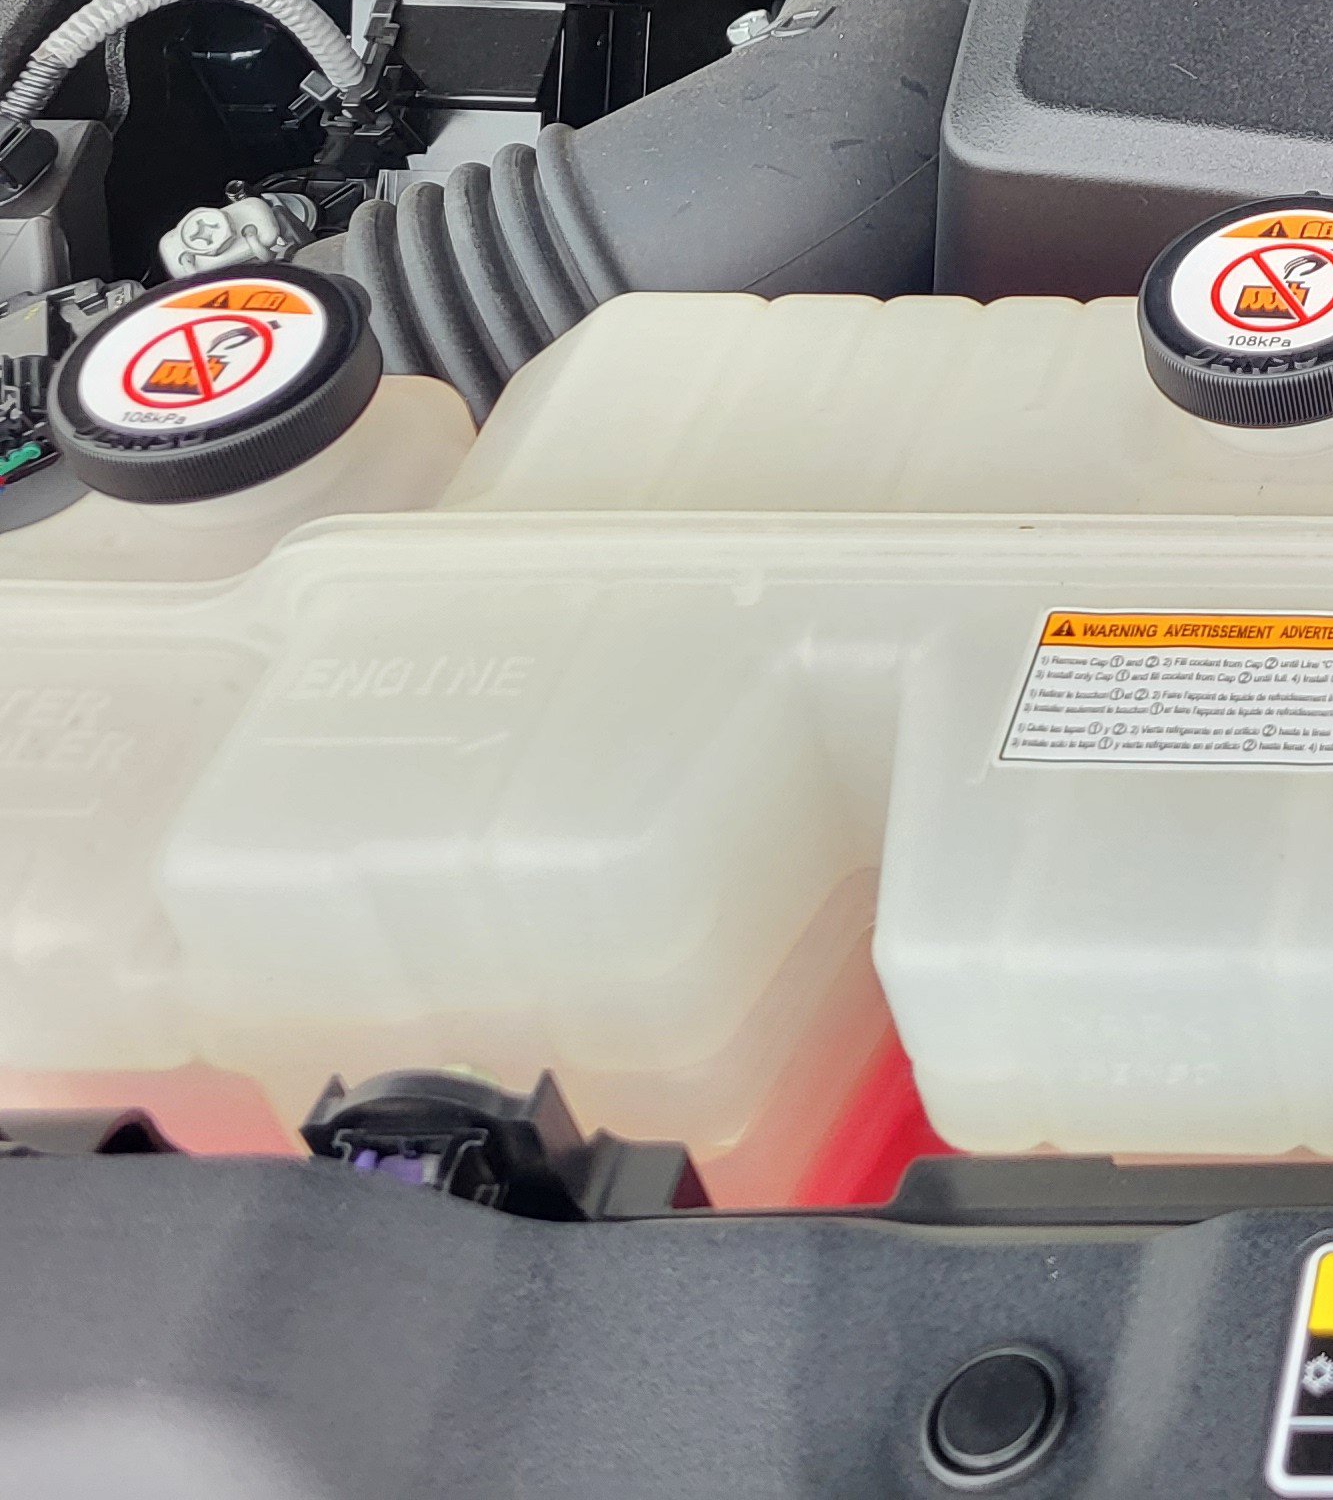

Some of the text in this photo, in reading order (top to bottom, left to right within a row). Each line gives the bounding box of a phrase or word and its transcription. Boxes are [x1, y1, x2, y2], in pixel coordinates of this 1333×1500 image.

[1227, 335, 1292, 348] 108kPa
[1082, 622, 1158, 638] WARNING
[1164, 623, 1275, 640] AVERTISSEMENT
